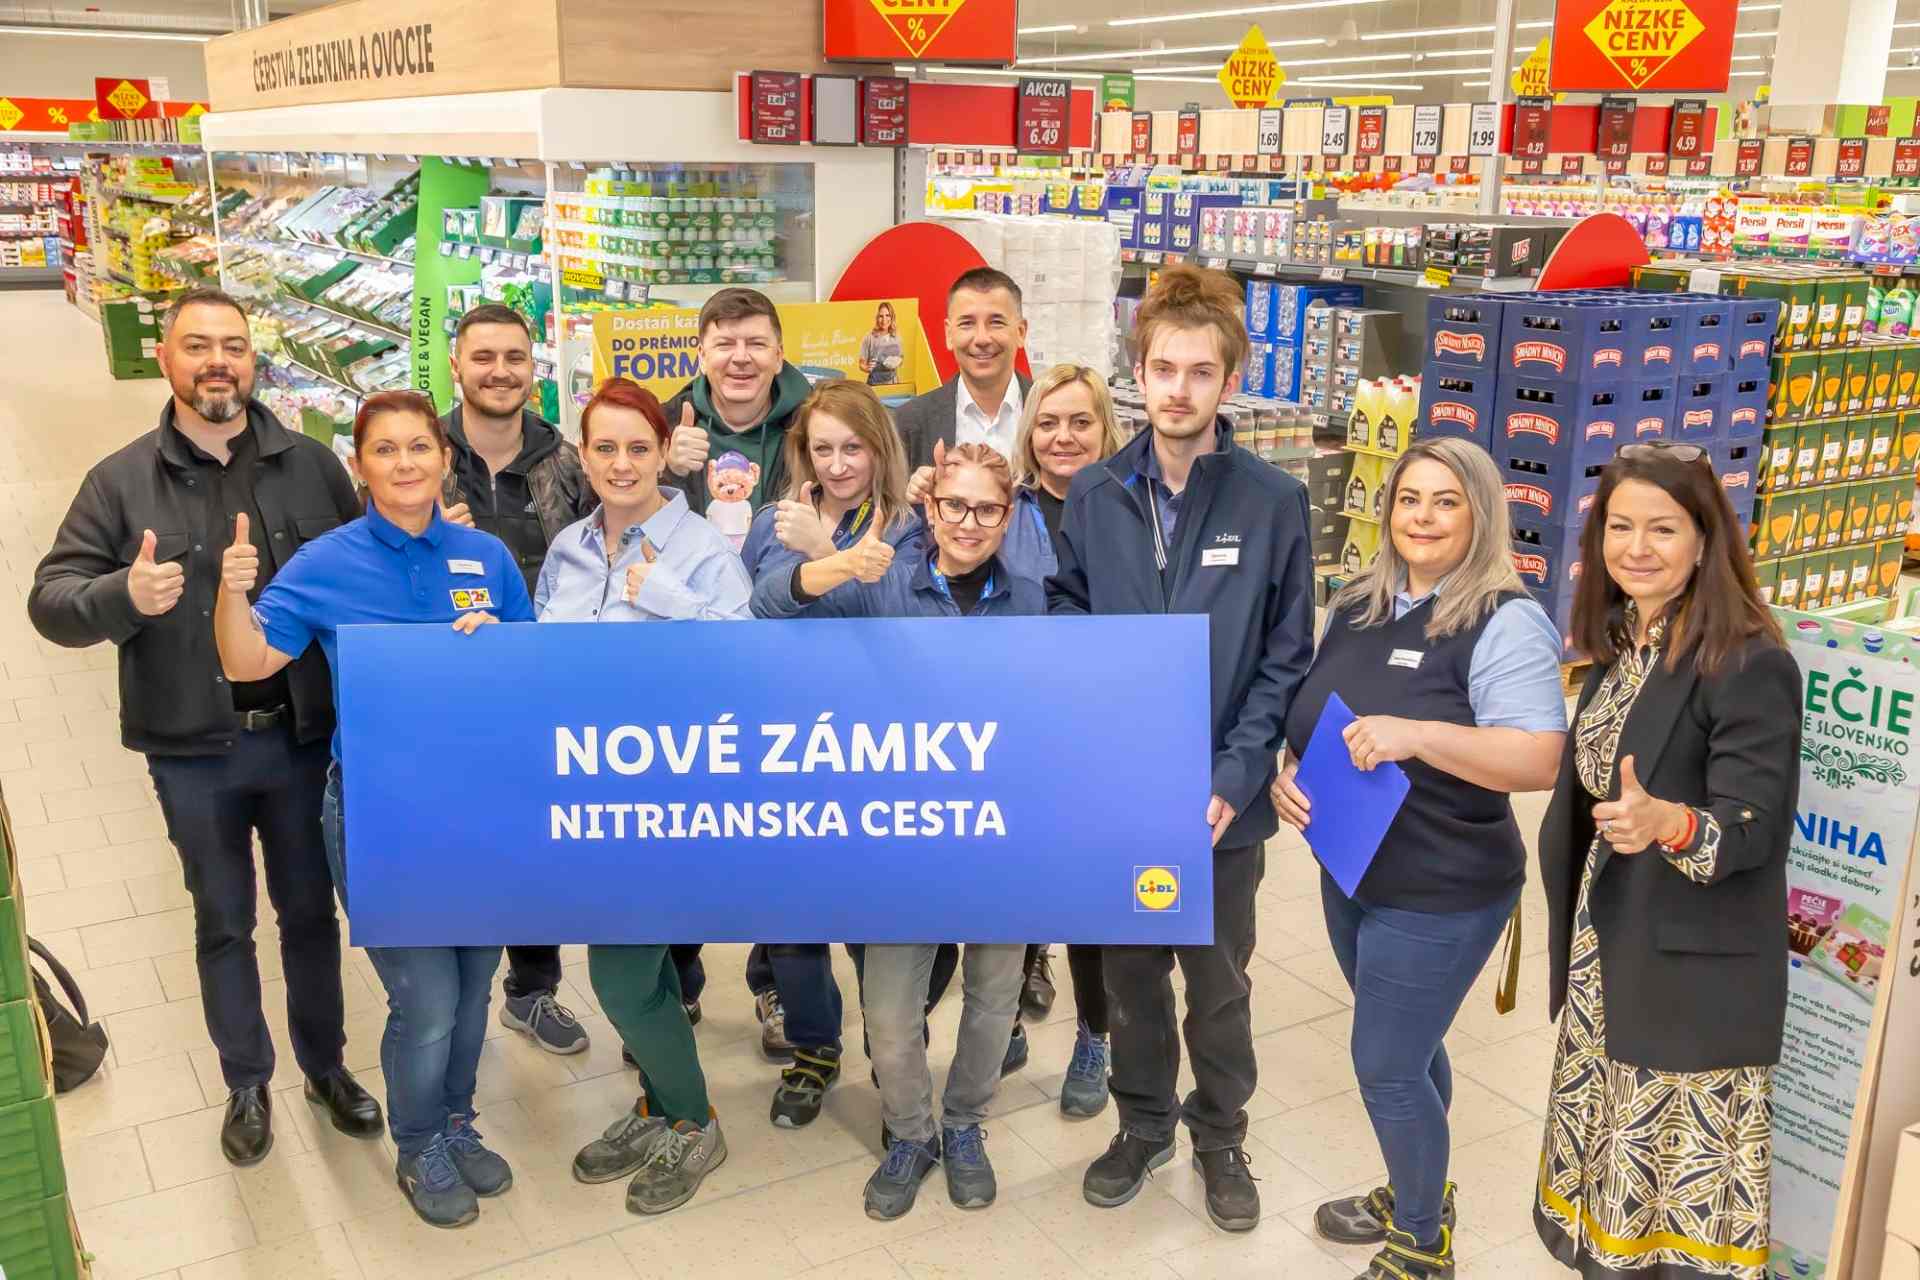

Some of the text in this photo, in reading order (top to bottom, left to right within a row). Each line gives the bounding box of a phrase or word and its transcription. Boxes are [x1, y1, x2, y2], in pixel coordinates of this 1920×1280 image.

[1604, 6, 1686, 29] NÍZKE
[1608, 31, 1678, 51] CENY
[253, 23, 434, 92] ČERSTVÁ ZELENINA A OVOCIE
[1229, 57, 1276, 78] NÍZKE
[1520, 66, 1546, 84] NÍZ
[1025, 82, 1066, 97] AKCIA
[1232, 79, 1272, 96] CENY
[1030, 128, 1059, 145] 6.49
[1261, 133, 1278, 147] 1.69
[1324, 132, 1344, 147] 2.45
[1415, 131, 1437, 147] 1.79
[1472, 130, 1494, 147] 1.99
[1676, 135, 1696, 151] 4.59
[1527, 142, 1544, 154] 0.23
[1740, 215, 1767, 229] Persil
[1776, 217, 1805, 229] Persil
[418, 296, 431, 347] VEGAN
[613, 314, 700, 331] Dostaň kaž
[612, 334, 699, 351] DO PRÉMIO
[614, 352, 700, 380] FORM
[419, 365, 430, 390] GIE
[1806, 666, 1914, 736] EČIE
[556, 711, 998, 775] NOVÉ ZÁMKY
[1817, 719, 1909, 756] SLOVENSKO
[550, 800, 1006, 839] NITRIANSKA CESTA
[1793, 811, 1887, 865] NIHA
[1840, 875, 1881, 895] dobroty
